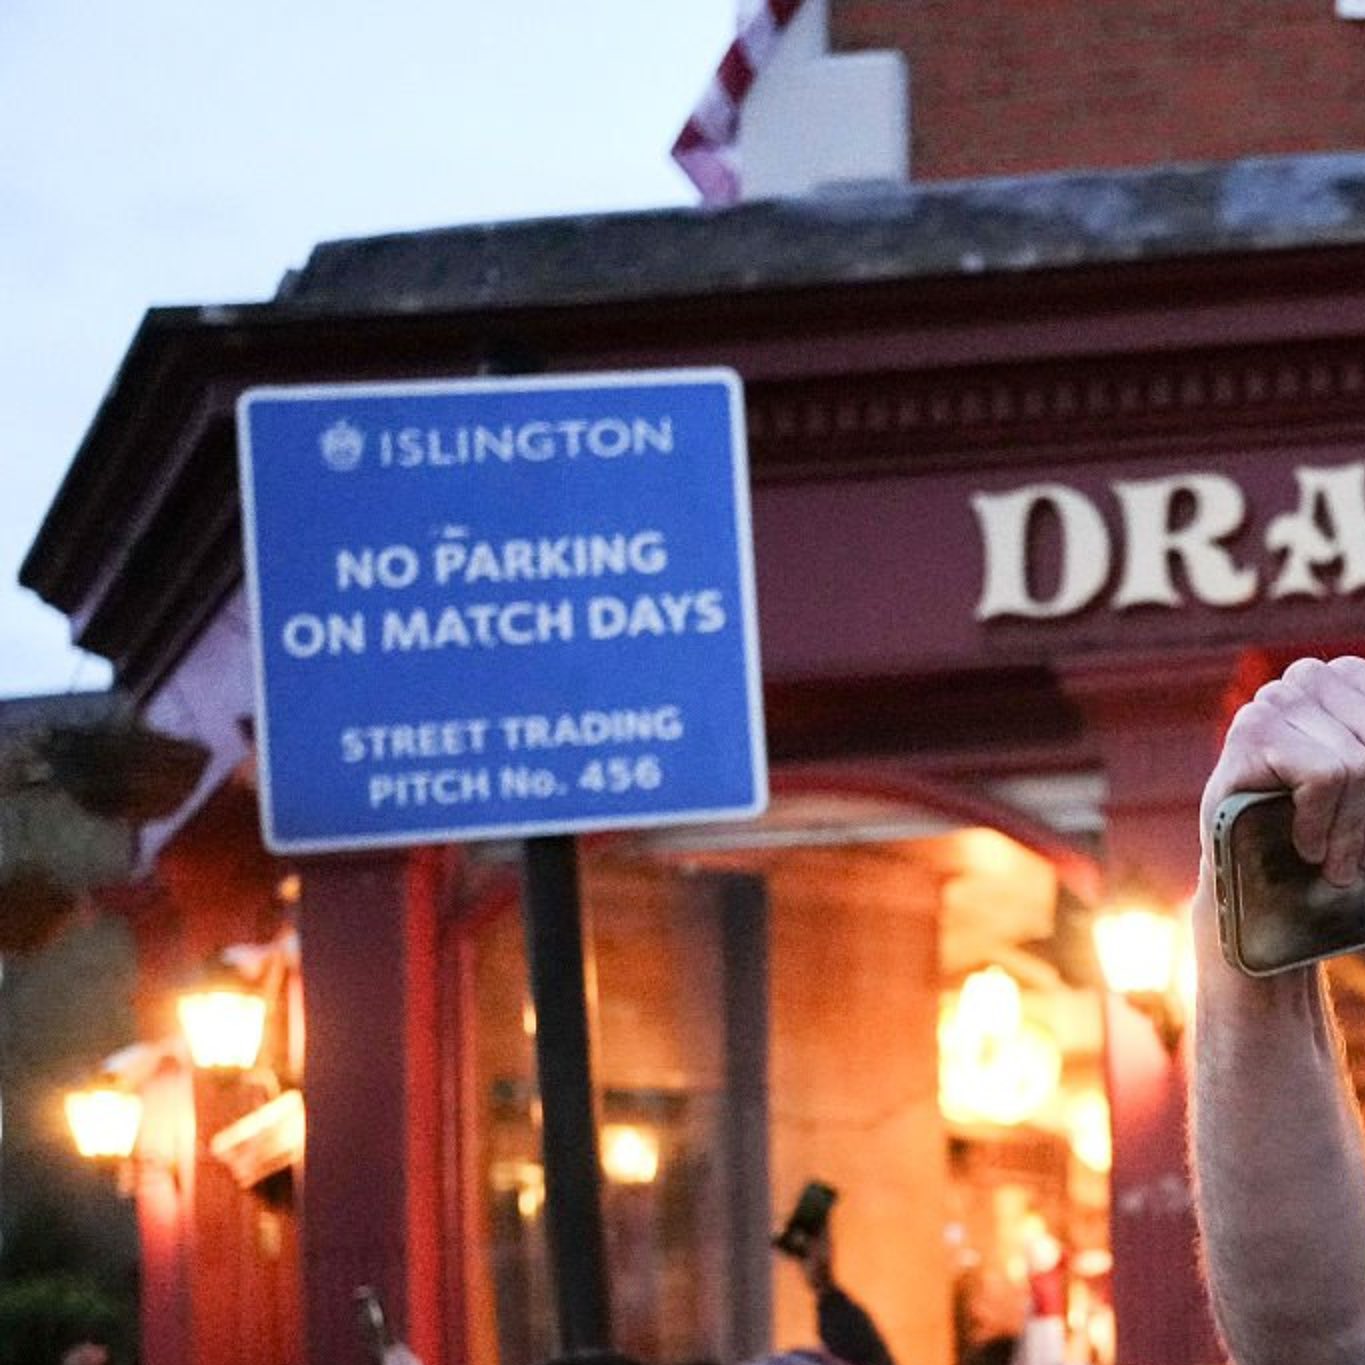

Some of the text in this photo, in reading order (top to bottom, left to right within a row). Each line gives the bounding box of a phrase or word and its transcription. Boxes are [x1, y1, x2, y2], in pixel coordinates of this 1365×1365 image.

[379, 415, 675, 468] ISLINGTON
[335, 530, 669, 591] NO PARKING
[281, 590, 727, 659] ON MATCH DAYS
[340, 705, 684, 763] STREET TRADING
[368, 757, 663, 808] PITCH No. 456
